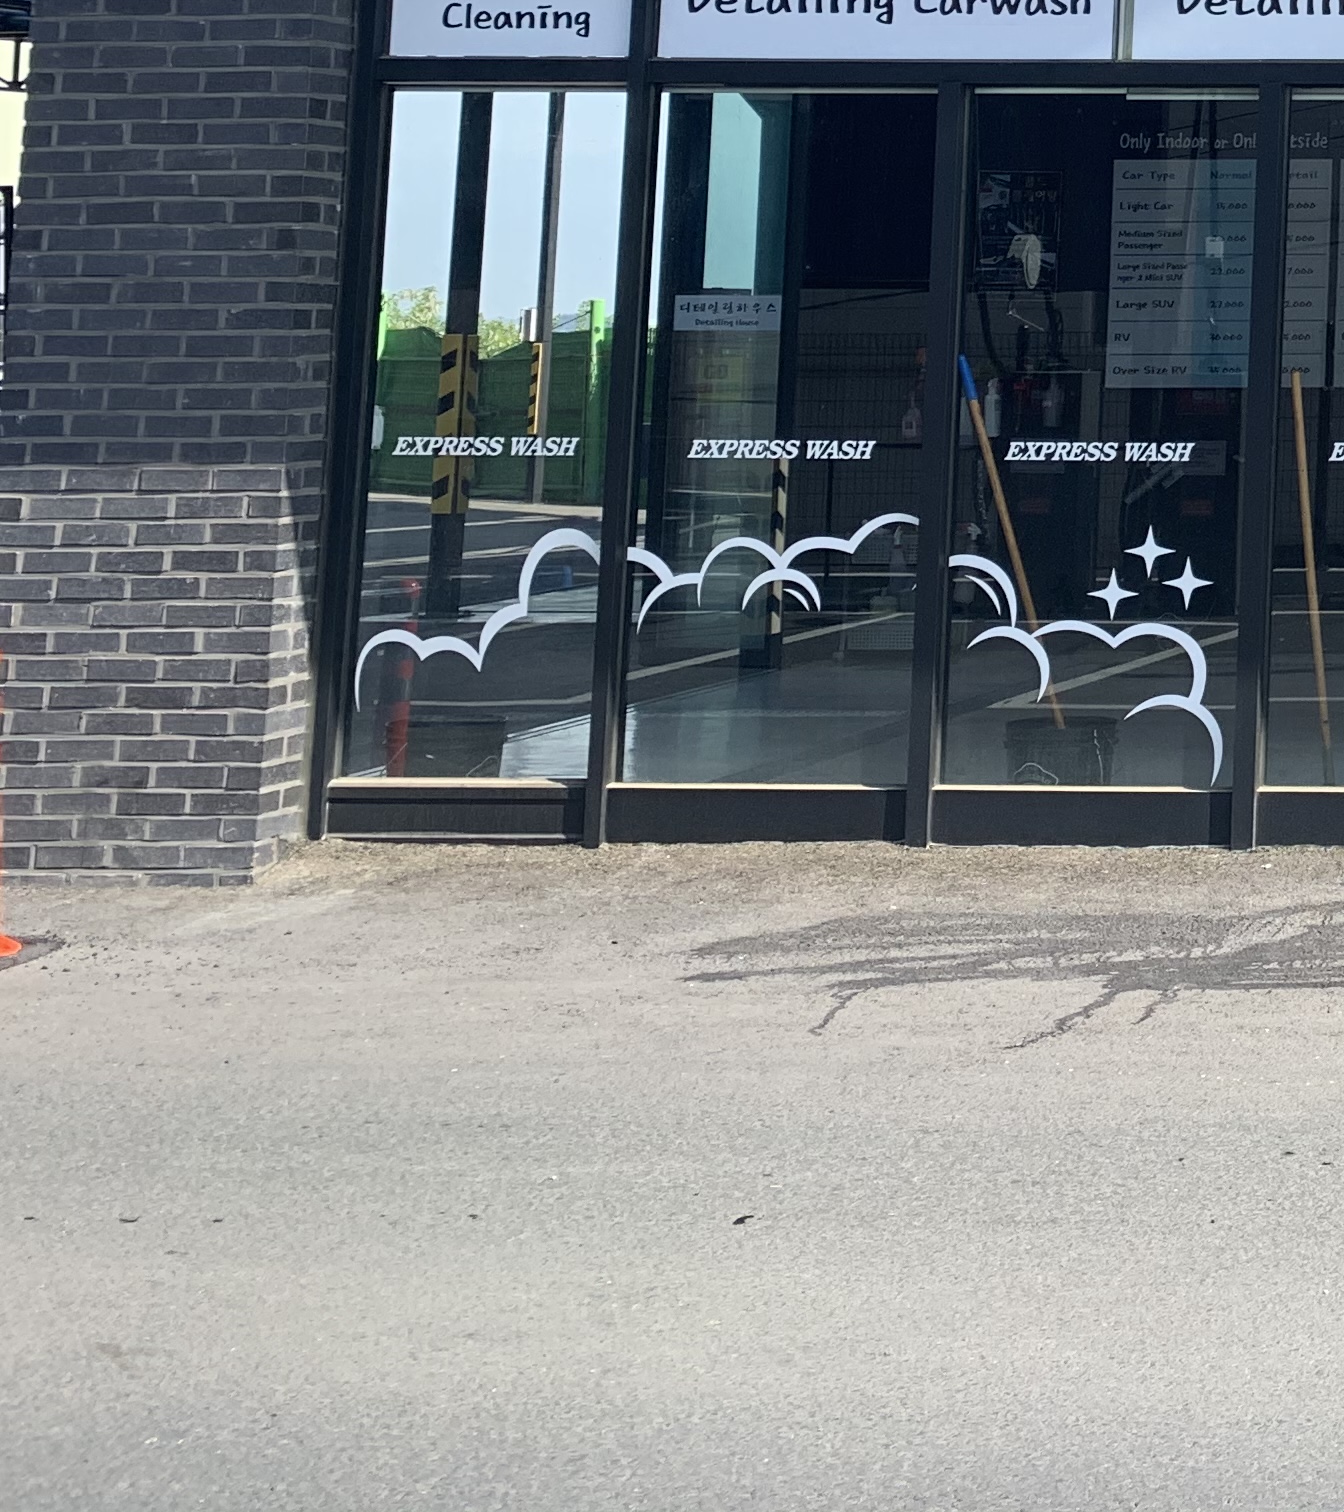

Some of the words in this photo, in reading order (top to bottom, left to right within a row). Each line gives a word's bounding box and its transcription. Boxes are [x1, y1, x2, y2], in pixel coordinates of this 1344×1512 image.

[443, 3, 590, 37] Cleaning
[1120, 133, 1151, 154] Only
[1156, 133, 1207, 149] Indoor
[1214, 138, 1228, 149] or
[1233, 133, 1256, 149] Onl
[1290, 132, 1329, 149] tside
[1122, 171, 1144, 180] Car
[1150, 171, 1175, 182] Type
[1210, 170, 1253, 180] Normal
[1119, 202, 1149, 213] Light
[1154, 202, 1174, 211] Car
[1118, 241, 1163, 252] Passenger
[1116, 300, 1147, 311] Large
[1152, 300, 1175, 309] SUV
[1114, 333, 1130, 342] RV
[1112, 366, 1140, 375] Over
[1143, 366, 1168, 375] Size
[1171, 366, 1188, 375] RV
[391, 436, 504, 458] EXPRESS
[509, 436, 579, 458] WASH
[687, 439, 801, 461] EXPRESS
[804, 439, 877, 461] WASH
[1004, 440, 1119, 464] EXPRESS
[1122, 440, 1196, 464] WASH
